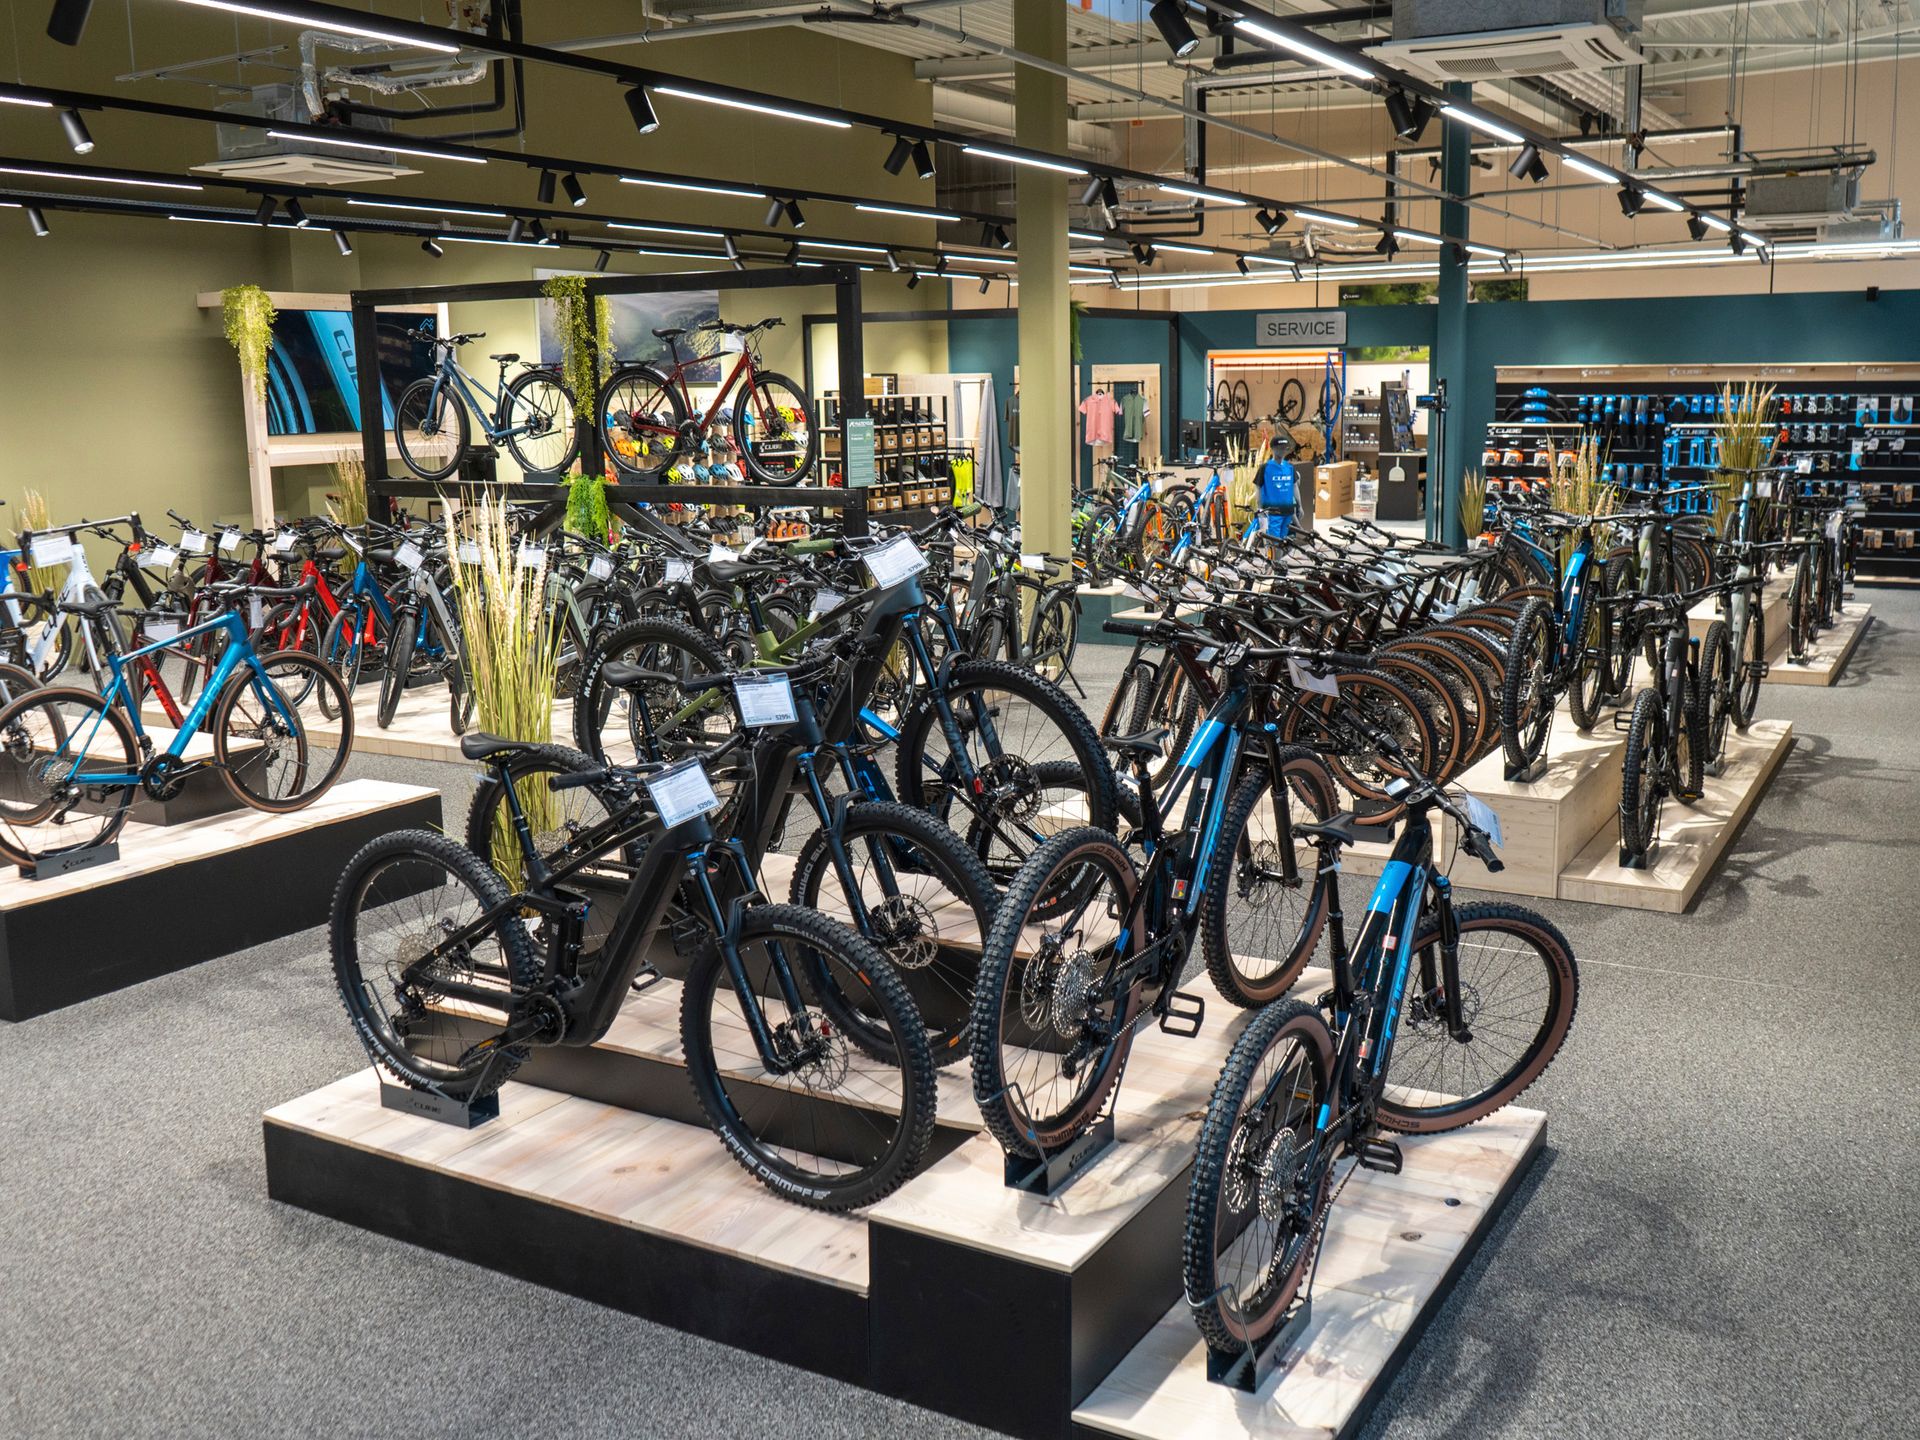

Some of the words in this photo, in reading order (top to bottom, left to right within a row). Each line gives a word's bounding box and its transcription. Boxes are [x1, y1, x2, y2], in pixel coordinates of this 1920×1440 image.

[1267, 321, 1336, 336] SERVICE
[583, 651, 607, 698] MAXXIS
[385, 1054, 429, 1088] DAMPF
[1037, 1110, 1091, 1144] SCHWALB
[720, 1125, 758, 1168] HANS
[757, 1164, 813, 1197] DAMPF
